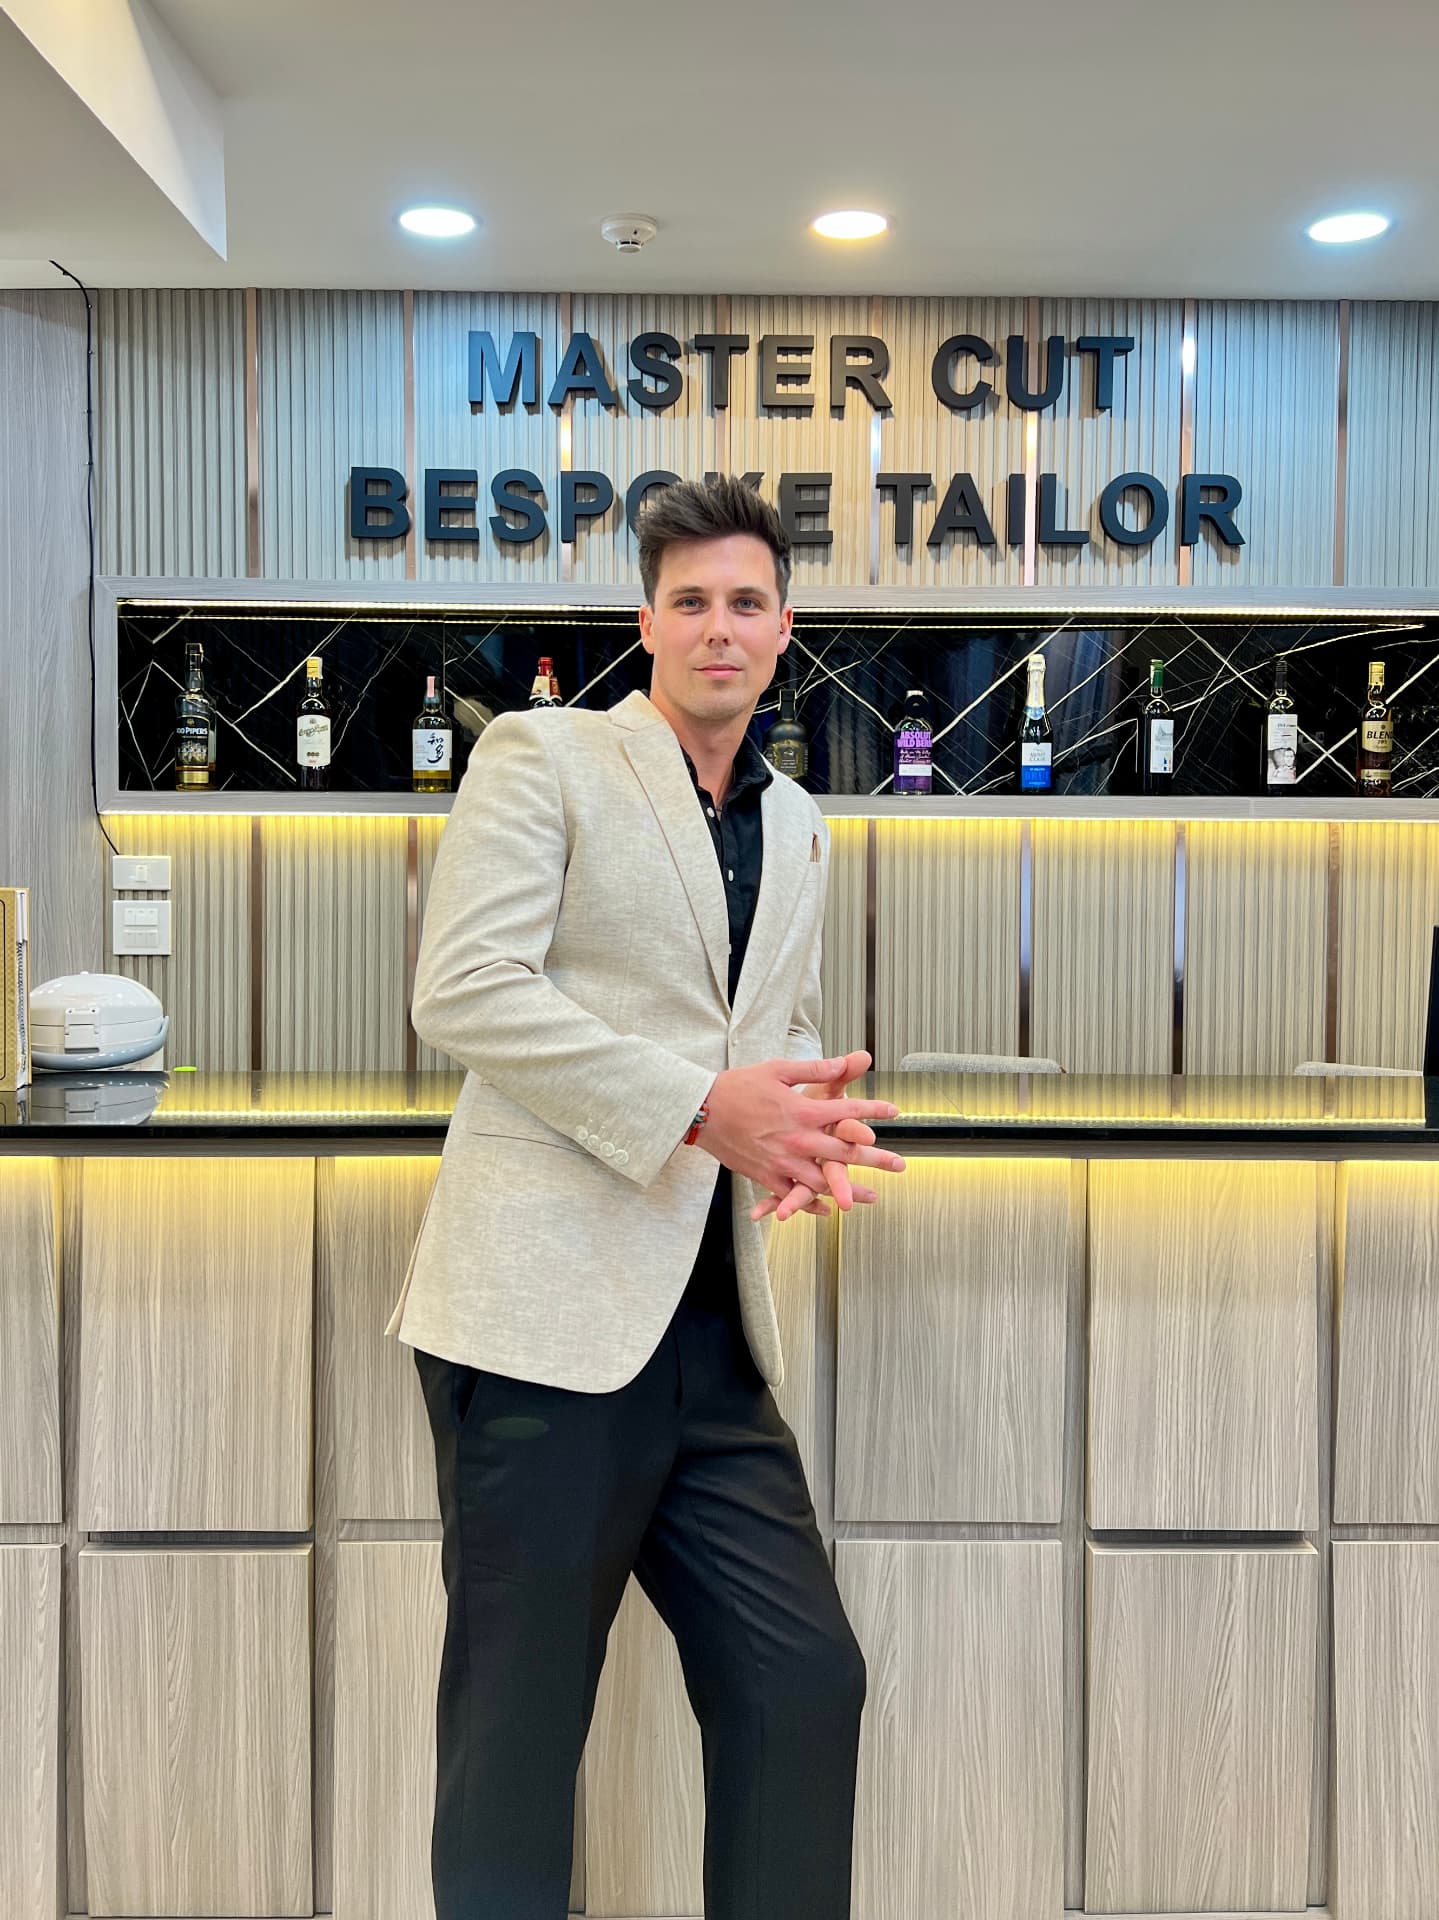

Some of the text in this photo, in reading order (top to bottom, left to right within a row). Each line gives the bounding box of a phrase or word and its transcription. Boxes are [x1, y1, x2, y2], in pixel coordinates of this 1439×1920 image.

[468, 331, 1135, 410] MASTER CUT
[351, 467, 1246, 546] BESPOE TAILOR
[897, 739, 915, 748] WILD
[899, 731, 931, 740] ABSOLUT
